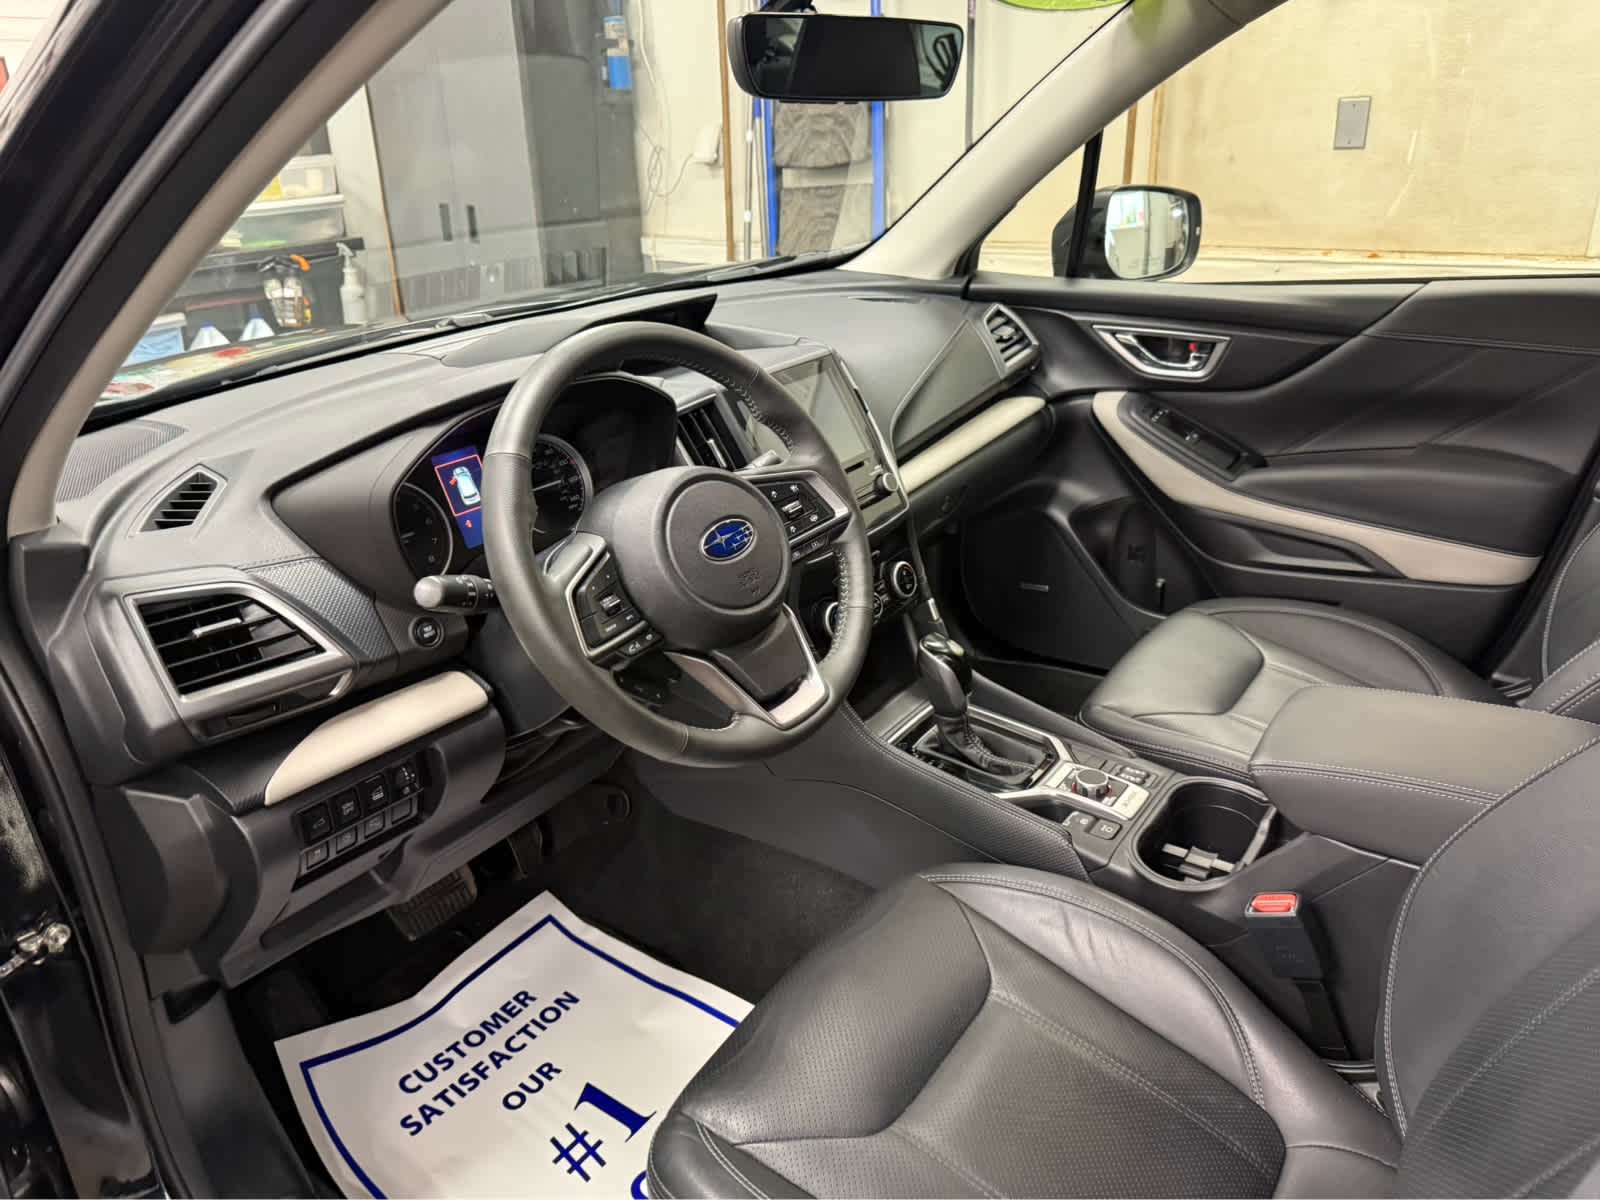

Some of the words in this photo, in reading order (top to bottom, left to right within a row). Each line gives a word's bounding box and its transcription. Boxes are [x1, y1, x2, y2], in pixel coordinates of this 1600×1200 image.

[398, 990, 537, 1094] CUSTOMER
[399, 991, 580, 1137] SATISFACTION
[502, 1062, 562, 1111] OUR
[550, 1082, 657, 1182] #1
